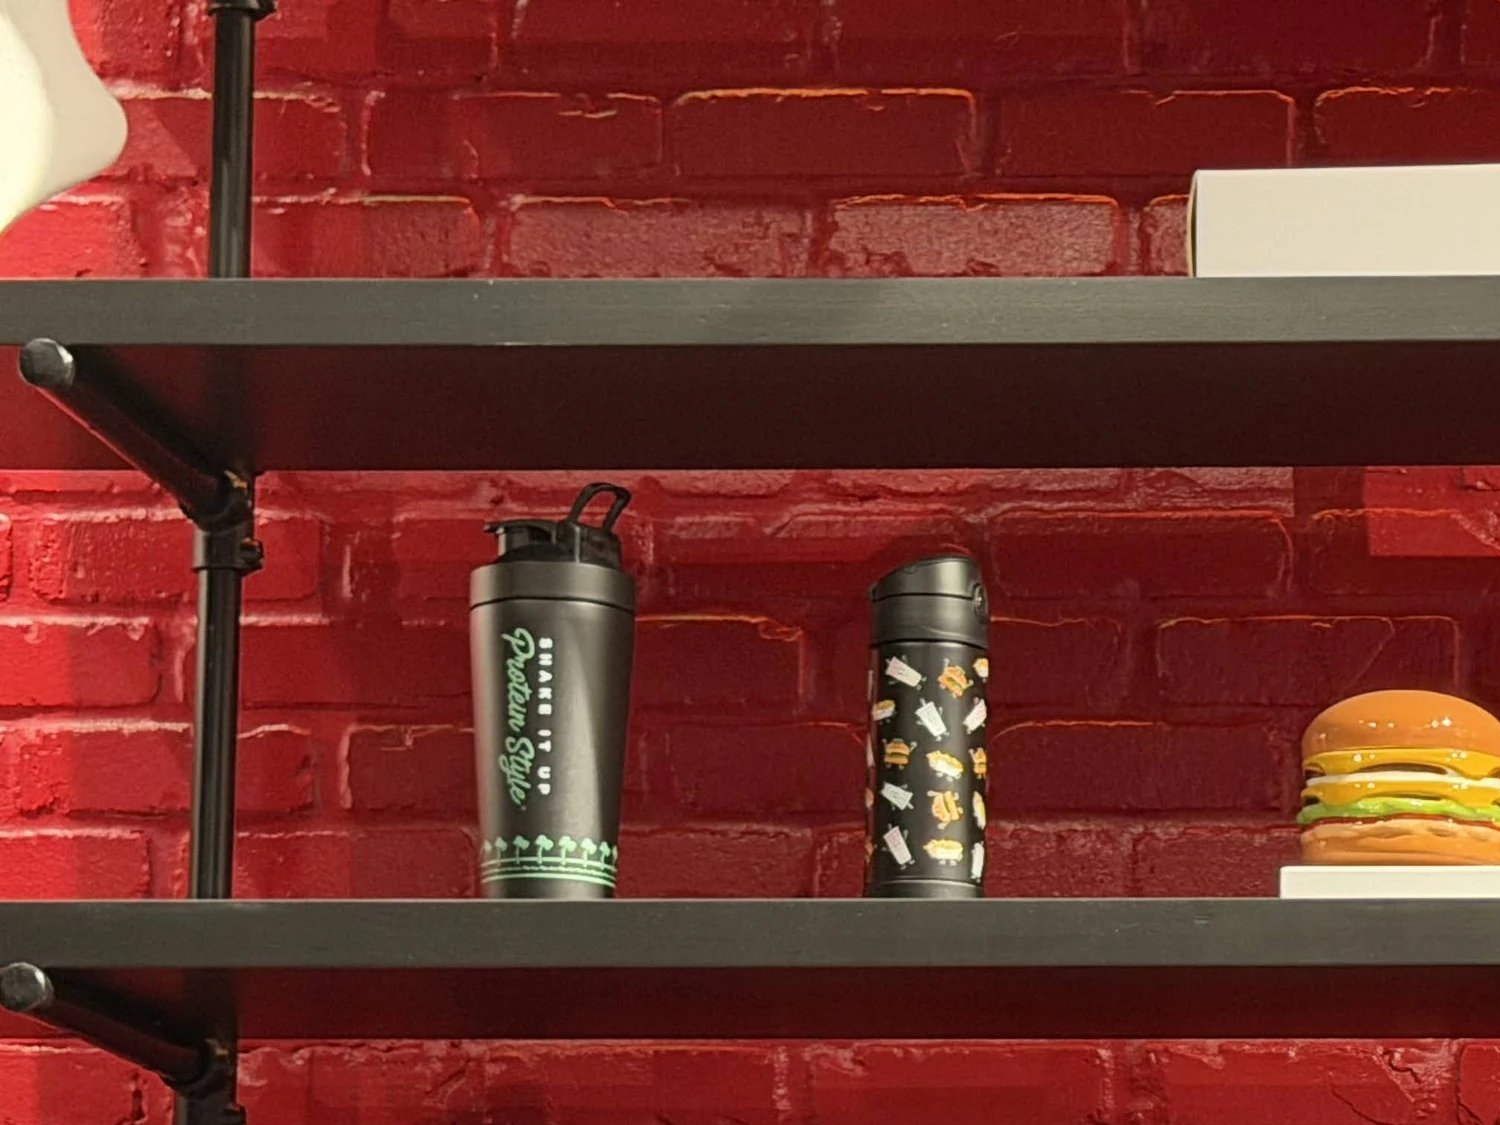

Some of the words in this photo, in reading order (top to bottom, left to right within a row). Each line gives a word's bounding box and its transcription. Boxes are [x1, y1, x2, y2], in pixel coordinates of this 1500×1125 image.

[501, 627, 535, 733] Protein
[538, 637, 553, 716] SHAKE
[499, 735, 535, 806] Style
[537, 729, 552, 752] IT
[537, 766, 551, 795] UP
